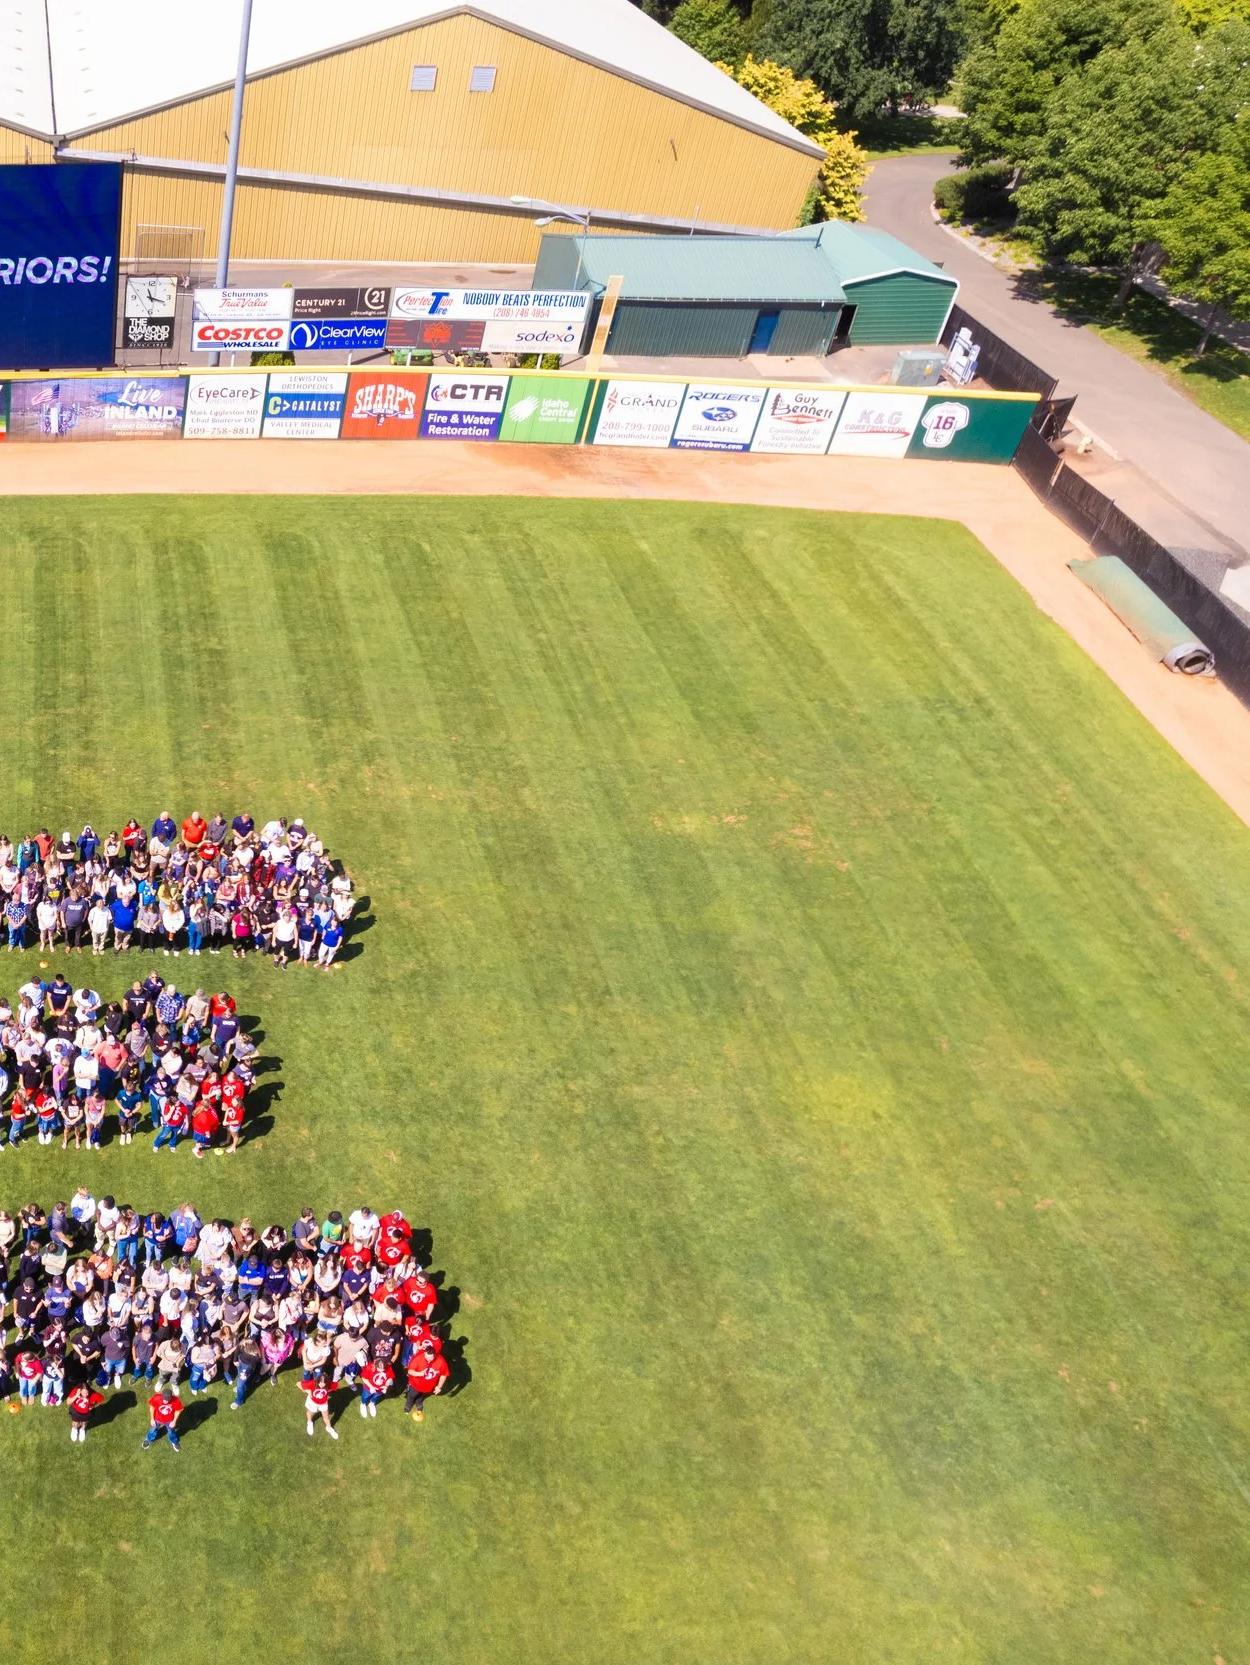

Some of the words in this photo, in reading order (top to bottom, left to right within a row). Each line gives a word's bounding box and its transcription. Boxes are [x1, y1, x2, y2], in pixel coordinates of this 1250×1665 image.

[295, 299, 336, 307] CENTURY
[462, 292, 501, 306] NOBODY
[502, 293, 531, 307] BEATS
[532, 294, 587, 308] PERFECTION
[493, 308, 514, 318] (208)
[530, 308, 551, 318] 4954
[129, 318, 148, 326] THE
[128, 325, 170, 334] DIAMOND
[197, 325, 284, 341] COSTCO
[319, 326, 385, 338] ClearView
[144, 332, 169, 341] SHOP
[516, 329, 575, 343] sodexo
[117, 380, 164, 407] Live
[198, 387, 249, 403] EyeCare
[449, 383, 504, 401] CTR
[688, 391, 761, 403] ROGERS
[353, 384, 417, 414] SHARP'S
[542, 398, 570, 408] Idaho
[620, 394, 678, 408] GRAND
[794, 393, 819, 406] Guy
[291, 400, 342, 412] CATALYST
[104, 406, 177, 420] INLAND
[539, 407, 579, 418] Central
[858, 409, 874, 424] K
[873, 412, 885, 425] &
[887, 411, 903, 426] G
[427, 413, 448, 424] Fire
[450, 413, 460, 424] &
[462, 414, 496, 425] Water
[933, 415, 956, 430] 16
[188, 427, 255, 435] 509-758-8811
[428, 425, 490, 436] Restoration
[602, 421, 670, 432] 208-799-1000
[691, 424, 739, 433] SUBARU
[769, 427, 810, 435] Committed
[844, 424, 906, 433] CONSTRUCTION
[676, 440, 743, 450] rogerssubaru.com
[757, 440, 788, 449] Forestry
